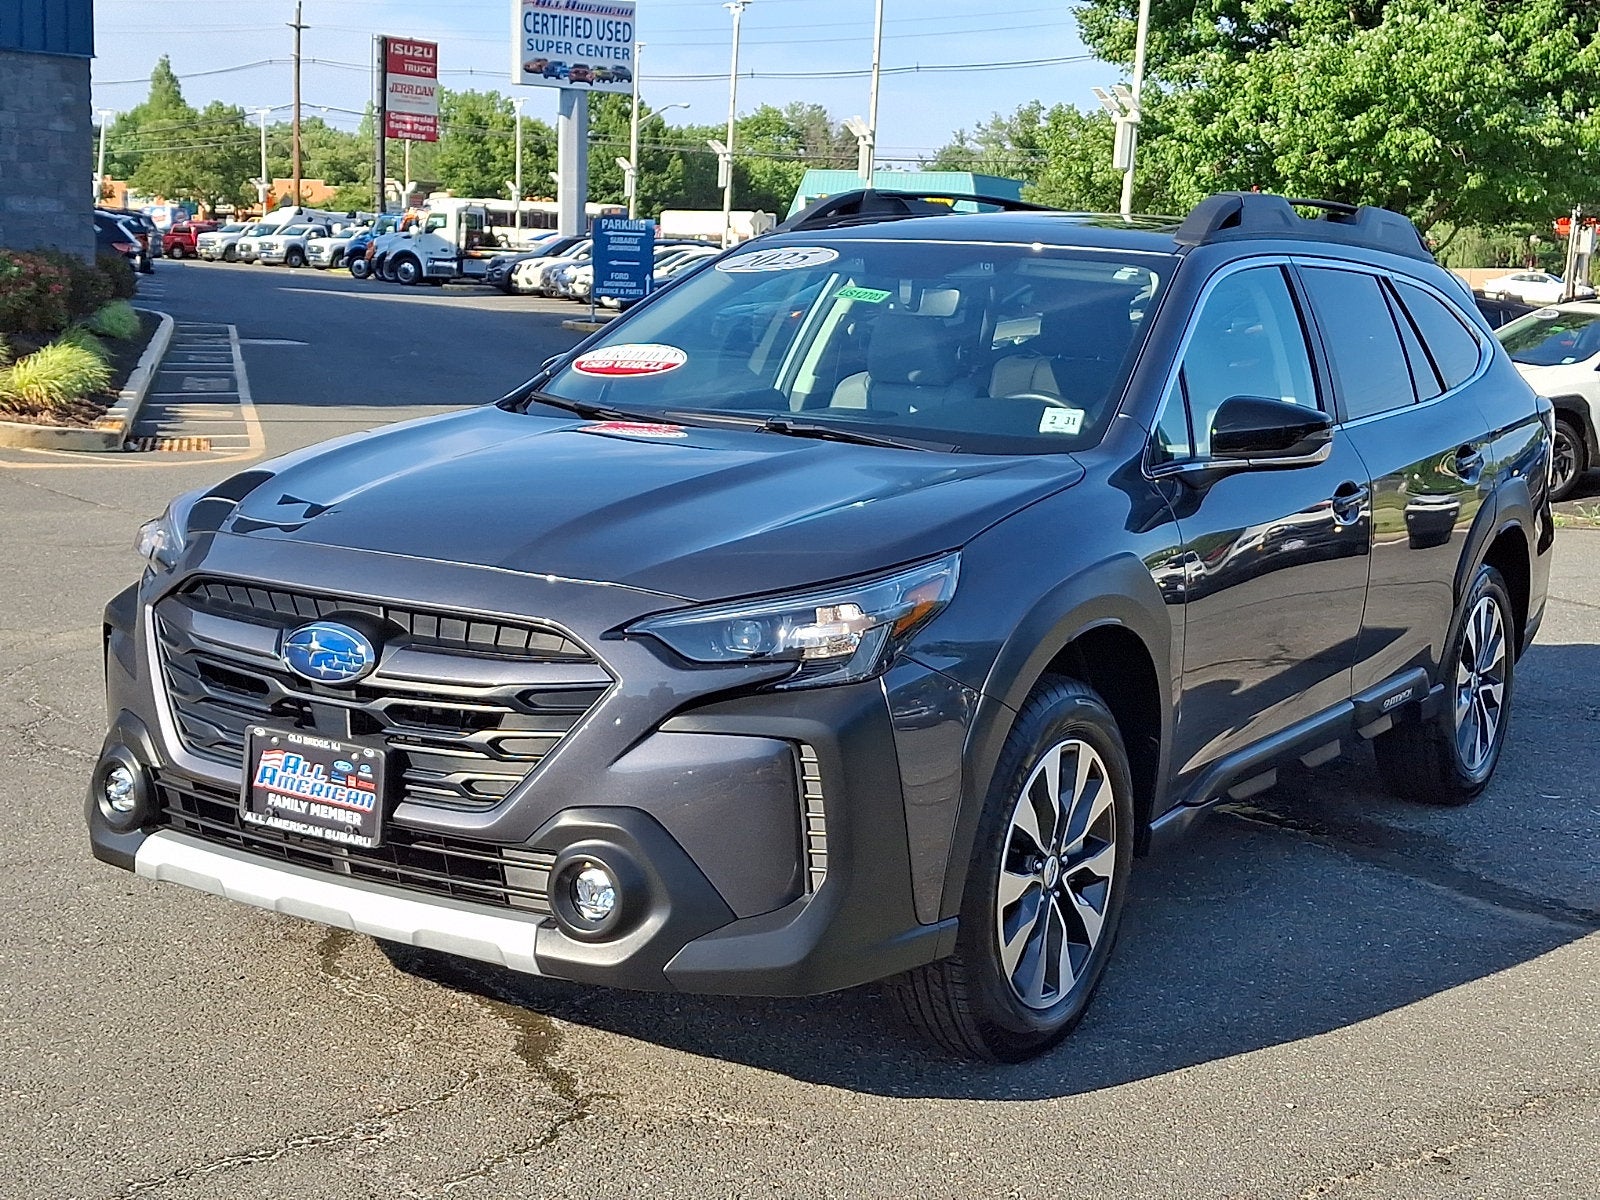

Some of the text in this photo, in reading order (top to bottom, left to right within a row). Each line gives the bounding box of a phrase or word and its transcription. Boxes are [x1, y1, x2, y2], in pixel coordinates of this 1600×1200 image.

[523, 11, 632, 43] CERTIFIED USED
[390, 42, 433, 58] ISUZU
[527, 38, 630, 60] SUPER CENTER
[403, 63, 432, 74] TRUCK
[601, 218, 646, 231] PARKING
[610, 236, 638, 244] SUBARU
[732, 251, 820, 269] 2025
[610, 272, 630, 280] FORD
[1049, 415, 1076, 425] 2 31
[288, 733, 303, 744] OLD
[267, 793, 362, 826] FAMILY MEMBER
[244, 812, 372, 847] ALL AMERICAN SUBARU
